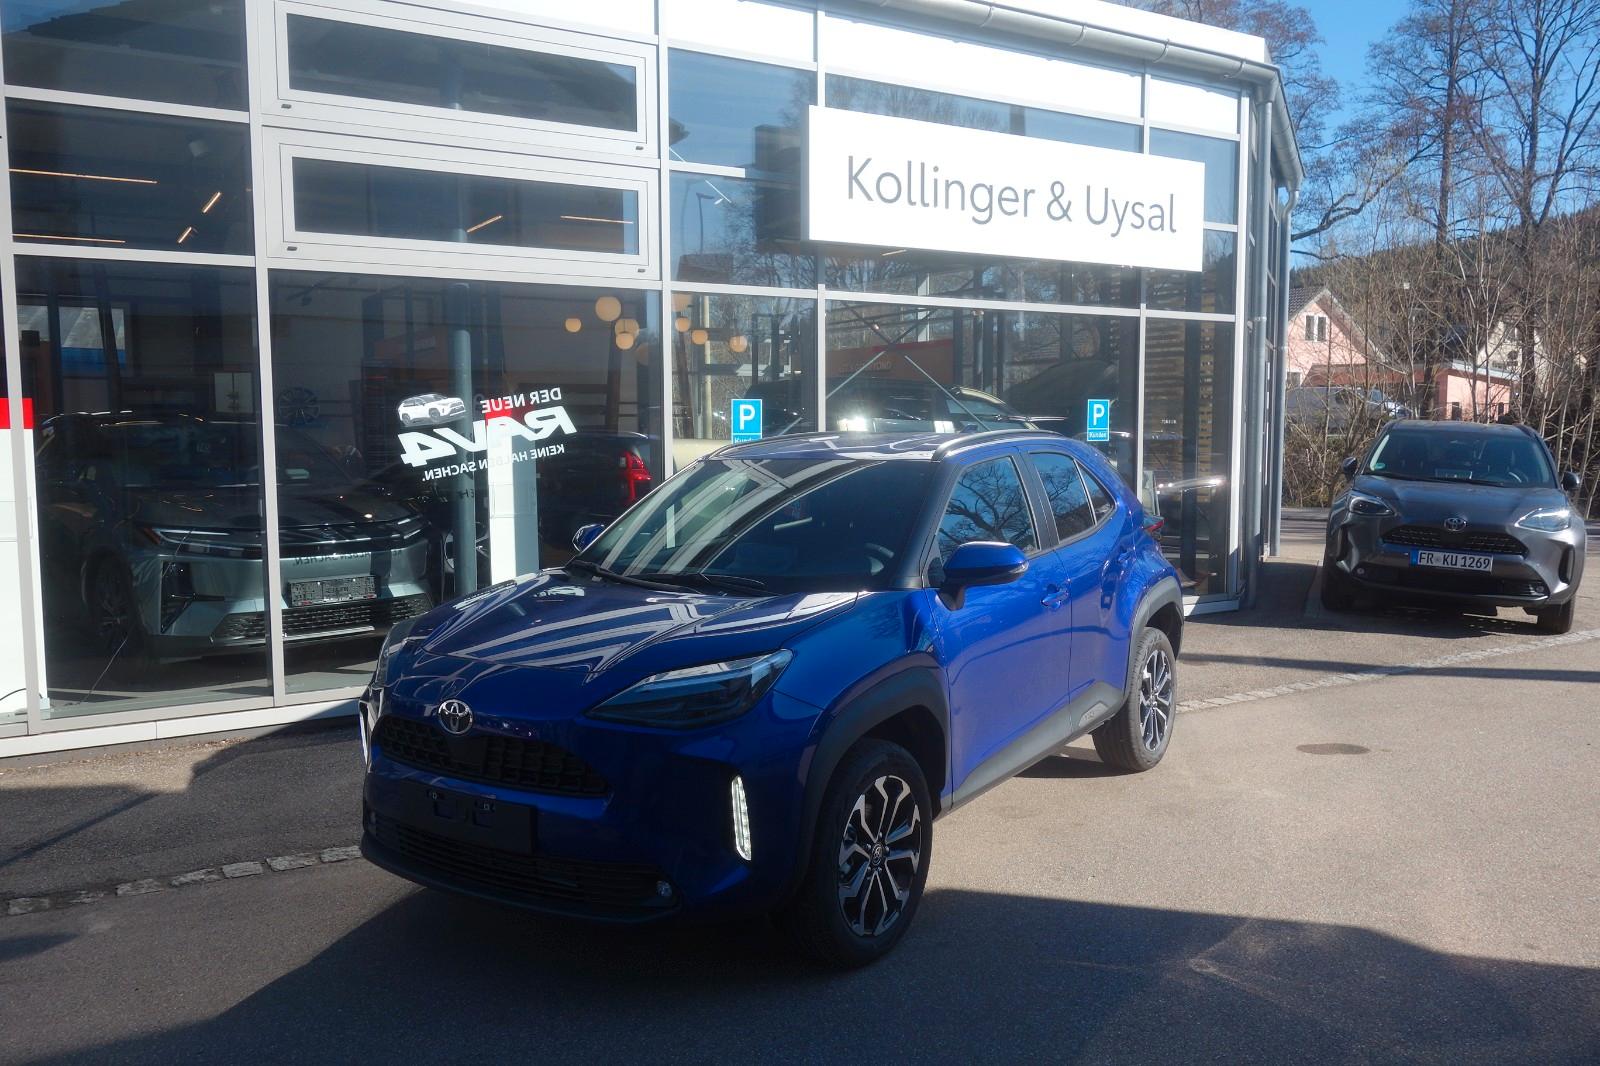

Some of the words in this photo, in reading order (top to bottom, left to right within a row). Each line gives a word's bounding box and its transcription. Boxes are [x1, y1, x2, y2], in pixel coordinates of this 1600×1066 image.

[848, 155, 1036, 225] Kollinger
[1046, 180, 1073, 222] &
[1086, 185, 1177, 238] Uysal
[740, 404, 756, 430] P
[1093, 403, 1105, 426] P
[1419, 552, 1434, 565] FR
[1442, 554, 1458, 566] KU
[1460, 556, 1490, 569] 1269
